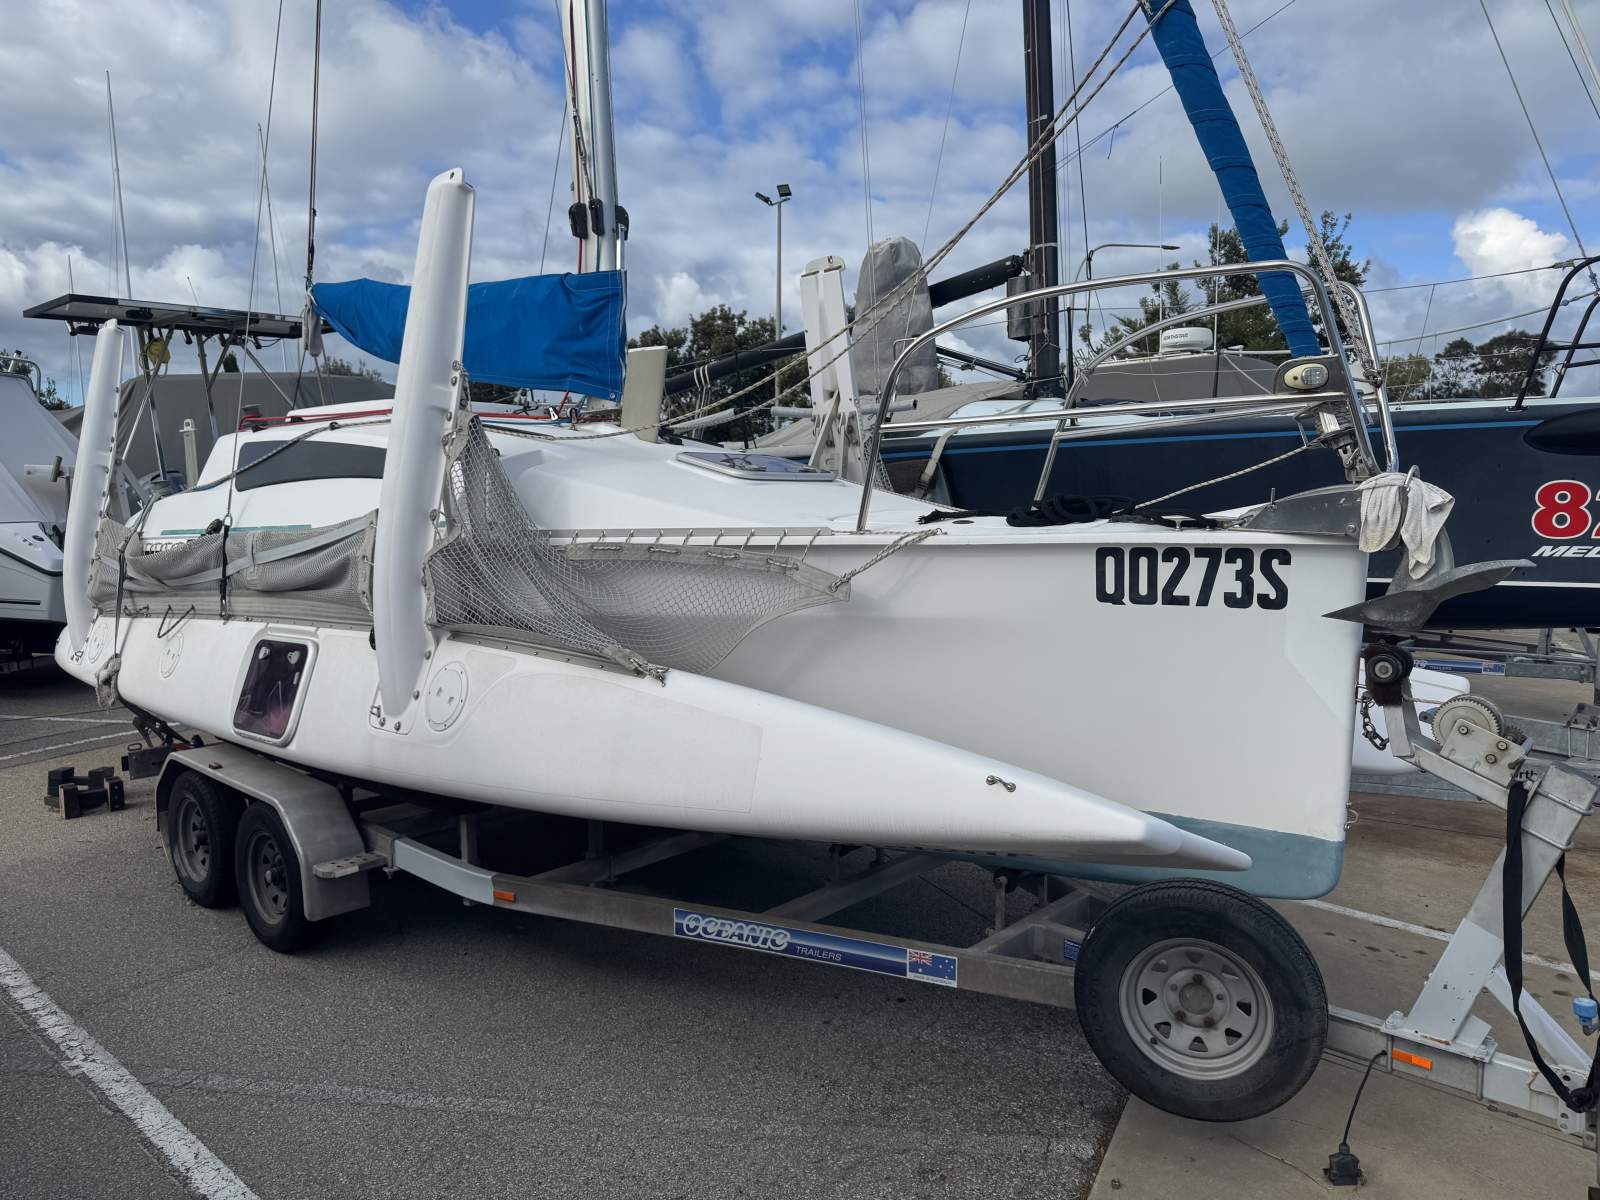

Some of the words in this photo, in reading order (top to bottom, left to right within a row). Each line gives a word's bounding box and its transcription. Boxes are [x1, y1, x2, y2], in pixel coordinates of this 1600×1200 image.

[1531, 480, 1600, 539] 8
[683, 914, 791, 951] OCEANIC
[795, 945, 842, 961] TRAILERS
